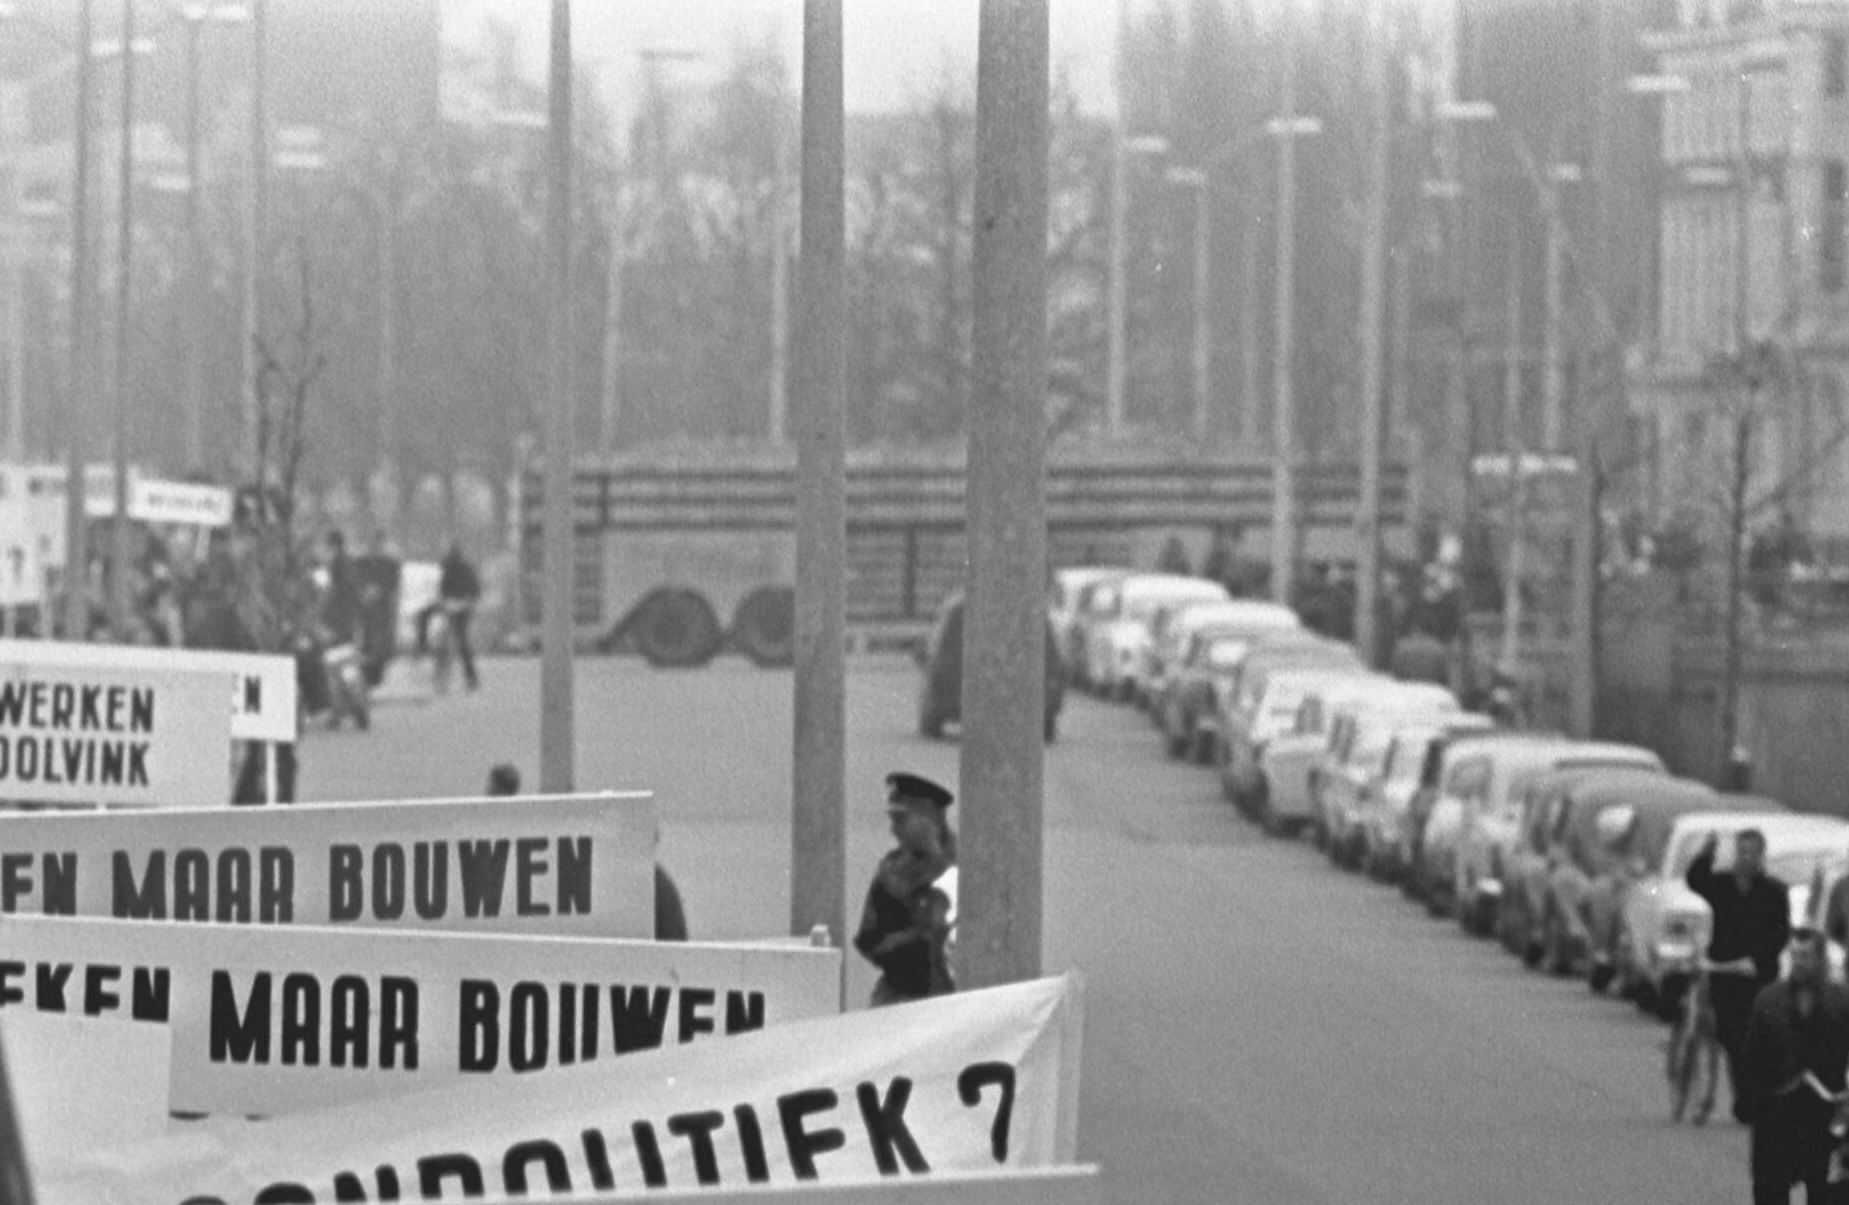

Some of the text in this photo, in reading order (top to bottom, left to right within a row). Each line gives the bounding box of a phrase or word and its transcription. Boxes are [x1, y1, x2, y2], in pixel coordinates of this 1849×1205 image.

[111, 846, 295, 924] MAAR
[329, 836, 593, 922] BOUWEN
[209, 969, 419, 1070] MAAR
[957, 1061, 1017, 1164] ?
